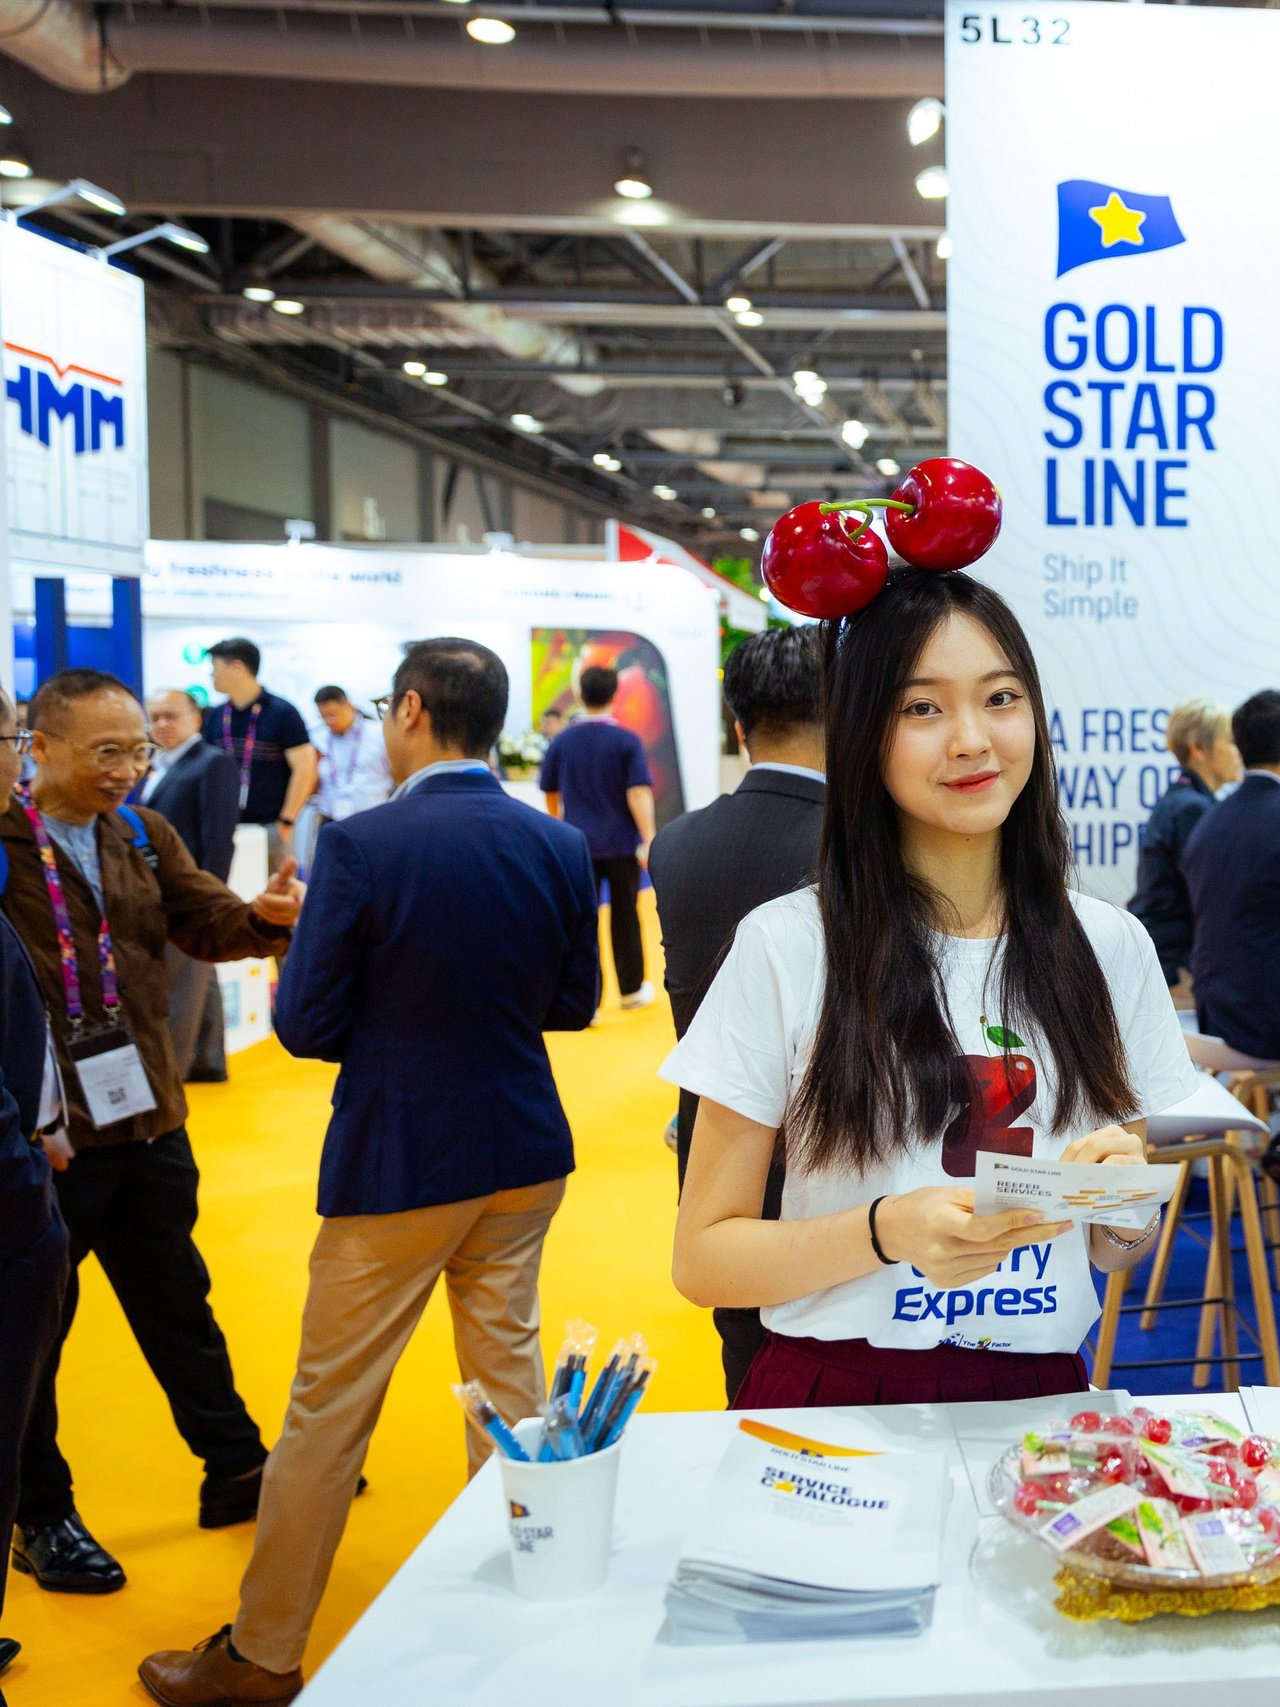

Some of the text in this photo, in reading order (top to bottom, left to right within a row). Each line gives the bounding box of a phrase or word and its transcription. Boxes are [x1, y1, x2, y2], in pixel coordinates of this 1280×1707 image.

[960, 14, 1071, 45] 5L32
[1044, 302, 1224, 373] GOLD
[1043, 380, 1216, 450] STAR
[1046, 457, 1188, 527] LINE
[1042, 552, 1129, 590] Ship It
[1042, 587, 1140, 625] Simple
[1050, 708, 1171, 753] A FRES
[996, 1186, 1053, 1197] SERVICES
[997, 1180, 1041, 1190] REEFER
[891, 1284, 1058, 1326] Express
[764, 1466, 853, 1496] SERVICE
